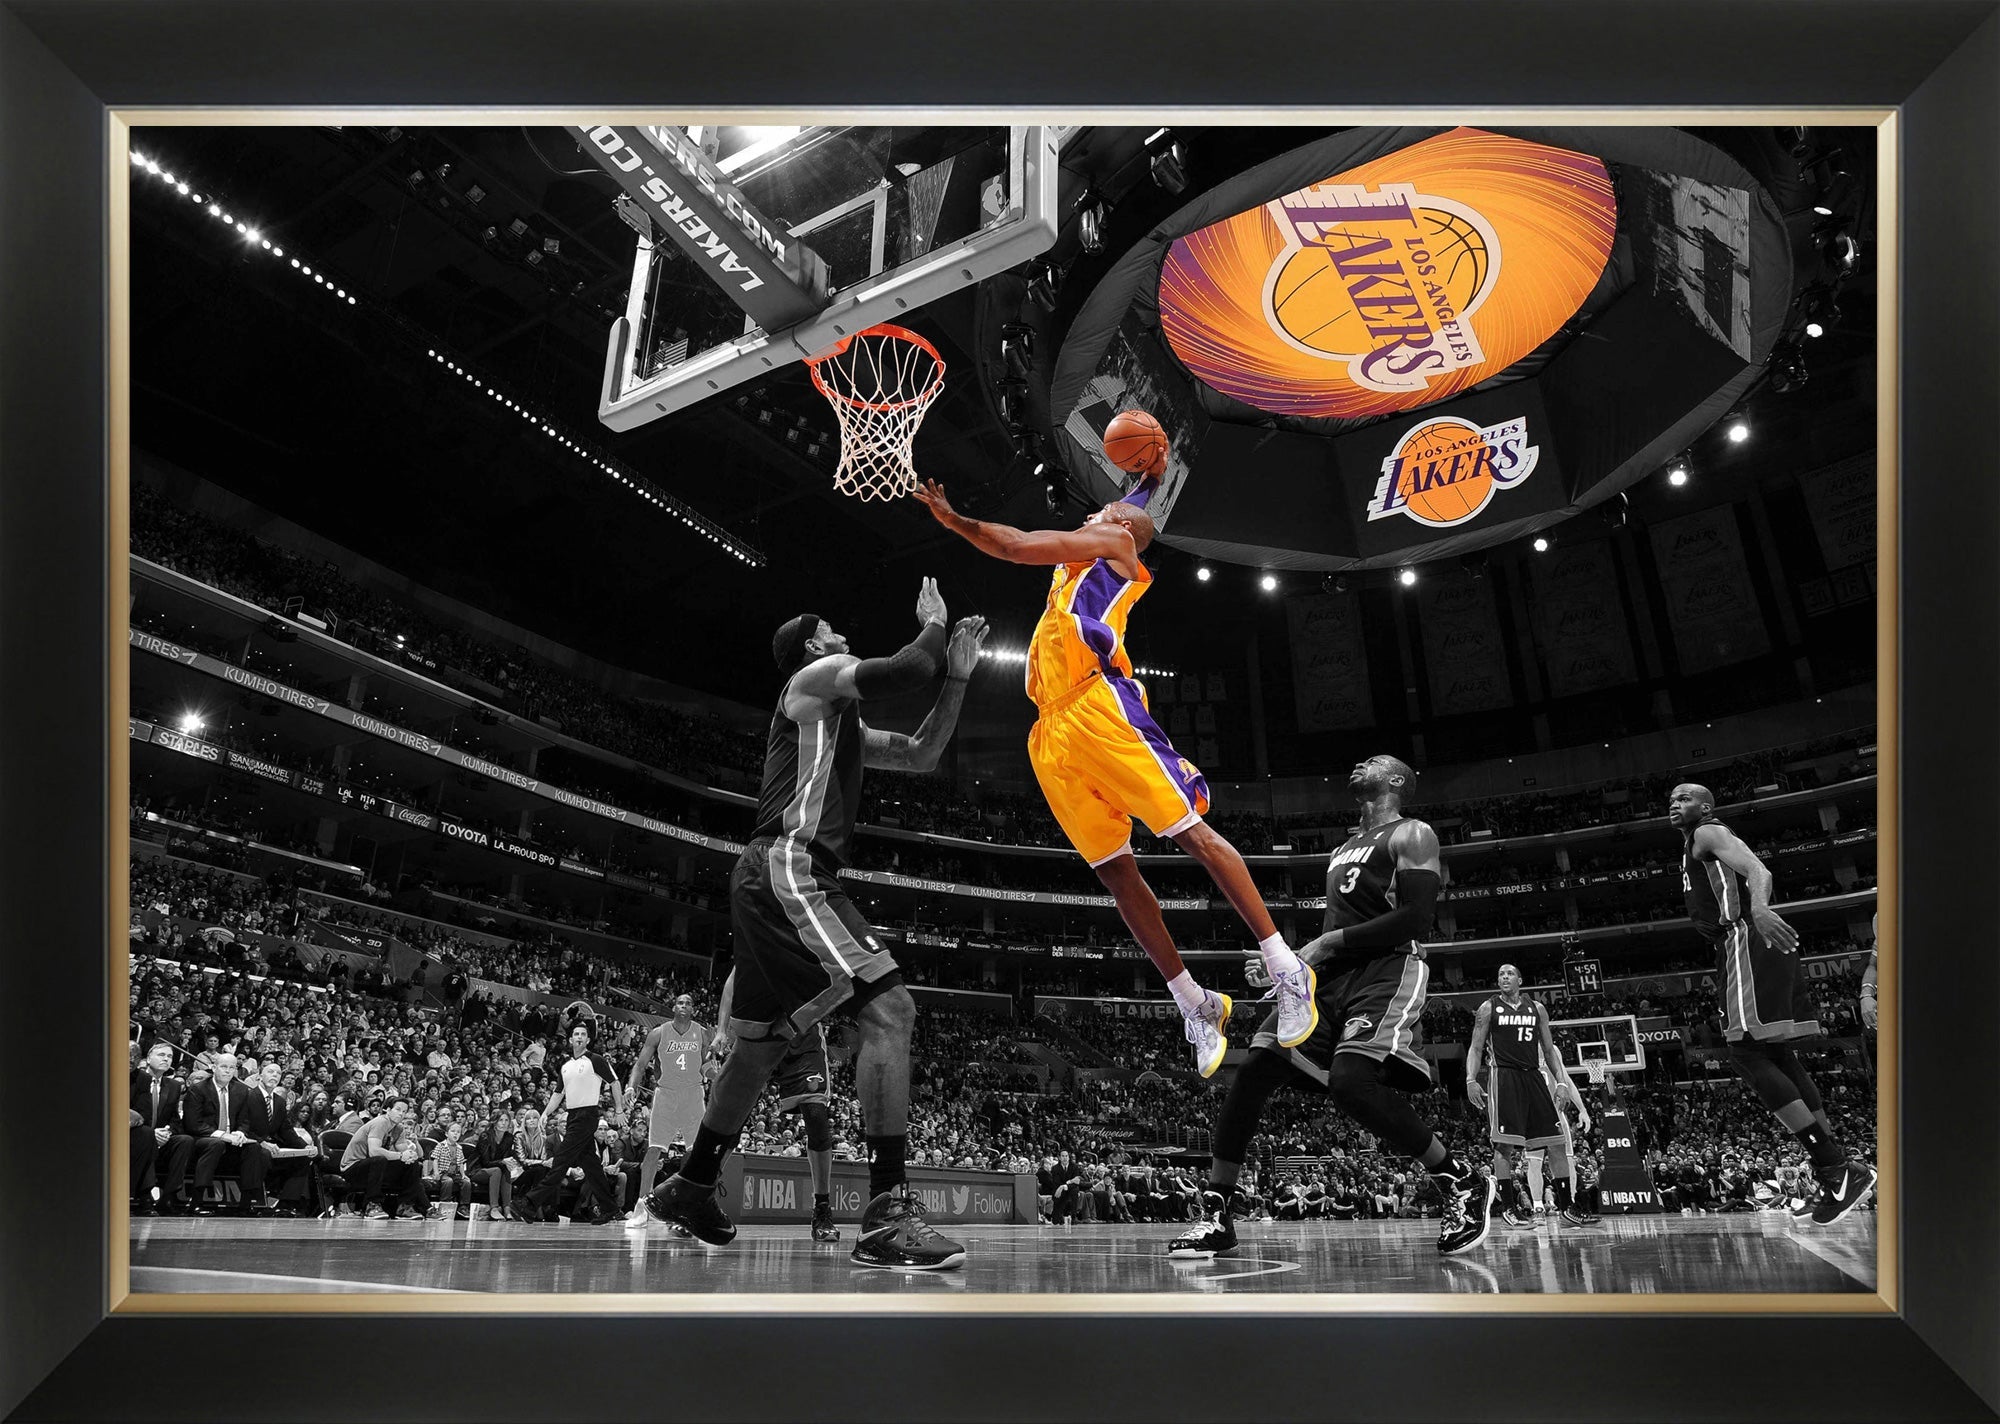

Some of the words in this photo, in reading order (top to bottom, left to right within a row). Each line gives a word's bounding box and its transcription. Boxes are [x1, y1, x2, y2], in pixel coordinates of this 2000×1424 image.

[577, 126, 764, 292] LAKERS.CO
[1279, 192, 1445, 386] LAKERS
[1404, 237, 1435, 276] LOS
[1422, 278, 1473, 362] ANGELES
[1416, 445, 1442, 461] LOS
[1446, 424, 1519, 453] ANGELES
[1376, 438, 1531, 513] LAKERS
[137, 633, 180, 659] TIRES
[224, 666, 276, 695] KUMHO
[280, 686, 315, 709] TIRES
[352, 714, 396, 739] KUMHO
[400, 731, 429, 751] TIRES
[159, 731, 219, 761] STAPLES
[231, 753, 249, 766] SAN
[256, 762, 289, 779] MANUEL
[460, 755, 499, 777] KUMHO
[500, 769, 527, 788] TIRES
[338, 787, 354, 798] LAL
[360, 794, 376, 805] MIA
[555, 789, 590, 810] KUMHO
[592, 801, 617, 818] TIRES
[441, 821, 488, 845] TOYOTA
[643, 818, 675, 837] KUMHO
[677, 829, 700, 843] TIRES
[1833, 834, 1866, 846] Panasonic
[539, 854, 555, 866] SPO
[889, 876, 921, 888] KUMHO
[923, 880, 946, 892] TIRES
[1339, 867, 1361, 894] 3
[1496, 883, 1534, 895] STAPLES
[971, 887, 1000, 898] KUMHO
[1003, 891, 1027, 901] TIRES
[1052, 894, 1082, 905] KUMHO
[1085, 896, 1109, 906] TIRES
[1459, 889, 1490, 898] DELTA
[1166, 900, 1190, 909] TIRES
[1573, 963, 1597, 974] 4:59
[1579, 974, 1597, 991] 14
[1100, 1003, 1181, 1019] @LAKER
[1498, 1015, 1536, 1027] MIAMI
[1517, 1027, 1533, 1042] 15
[1629, 1030, 1681, 1043] TOYOTA
[667, 1040, 698, 1053] LAKERS
[676, 1054, 686, 1070] 4
[1079, 1125, 1136, 1138] Budweiser
[759, 1179, 796, 1209] NBA
[830, 1184, 861, 1211] ike
[974, 1192, 1012, 1215] Follow
[1613, 1191, 1635, 1204] NBA
[1636, 1191, 1652, 1203] TV
